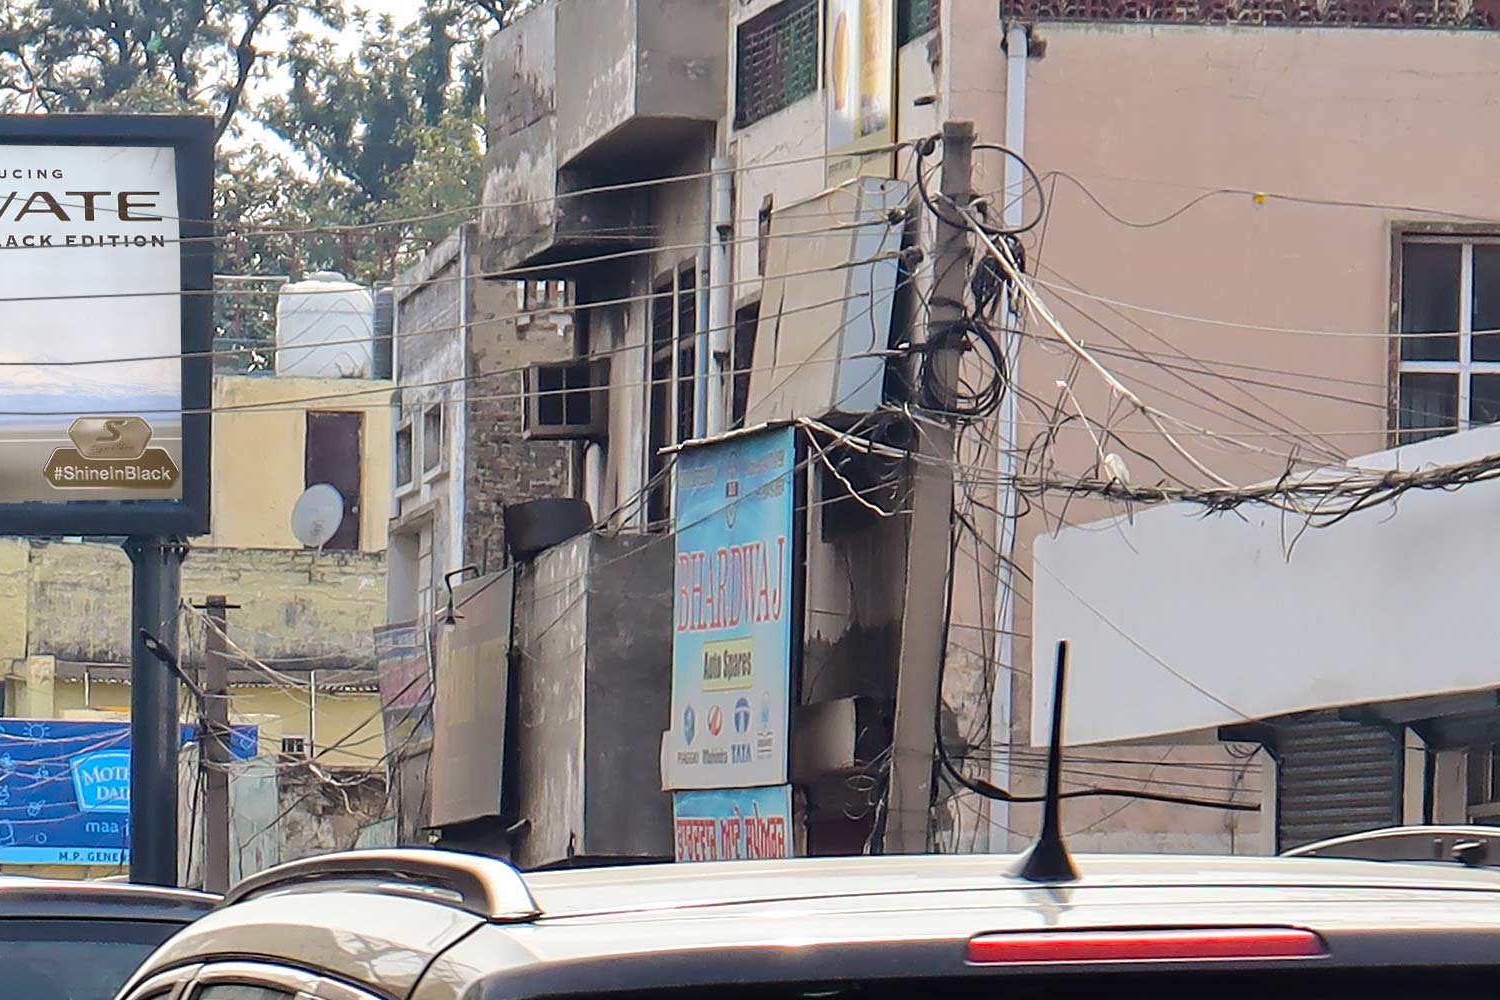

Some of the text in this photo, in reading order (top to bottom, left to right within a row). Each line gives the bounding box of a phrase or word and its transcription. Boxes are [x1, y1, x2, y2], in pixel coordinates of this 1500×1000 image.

[66, 235, 164, 247] EDITION
[54, 466, 172, 480] #ShineInBlack
[677, 537, 785, 631] BHARDWAJ
[723, 649, 752, 681] Spares
[731, 743, 752, 764] TATA
[85, 821, 119, 833] maa
[58, 852, 84, 862] M.P.
